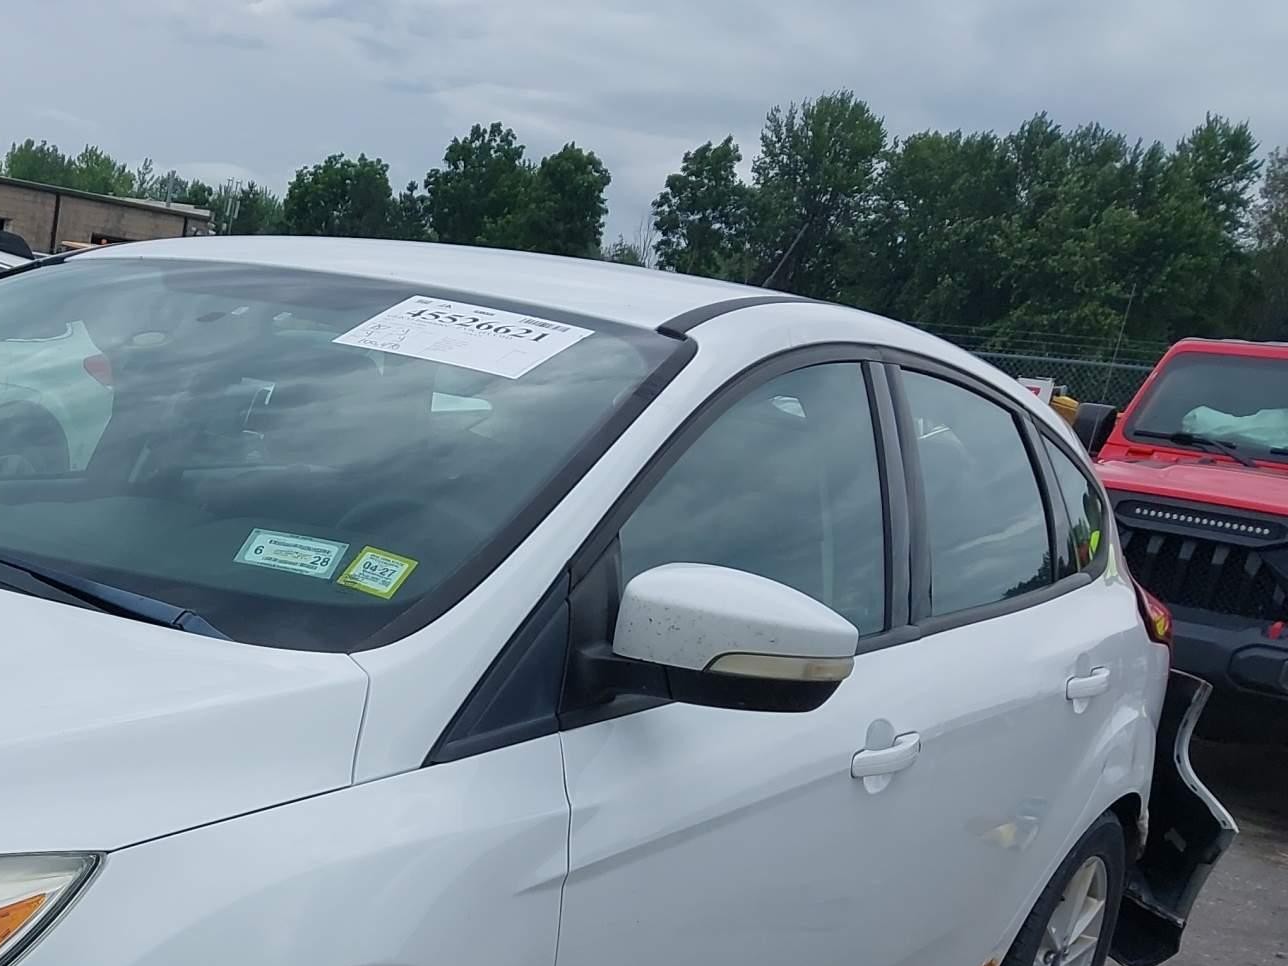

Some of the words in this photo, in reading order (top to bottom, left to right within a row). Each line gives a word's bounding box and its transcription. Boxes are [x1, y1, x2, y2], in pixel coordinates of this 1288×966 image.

[406, 308, 549, 342] 45526621
[254, 545, 264, 556] 6
[310, 555, 331, 567] 28
